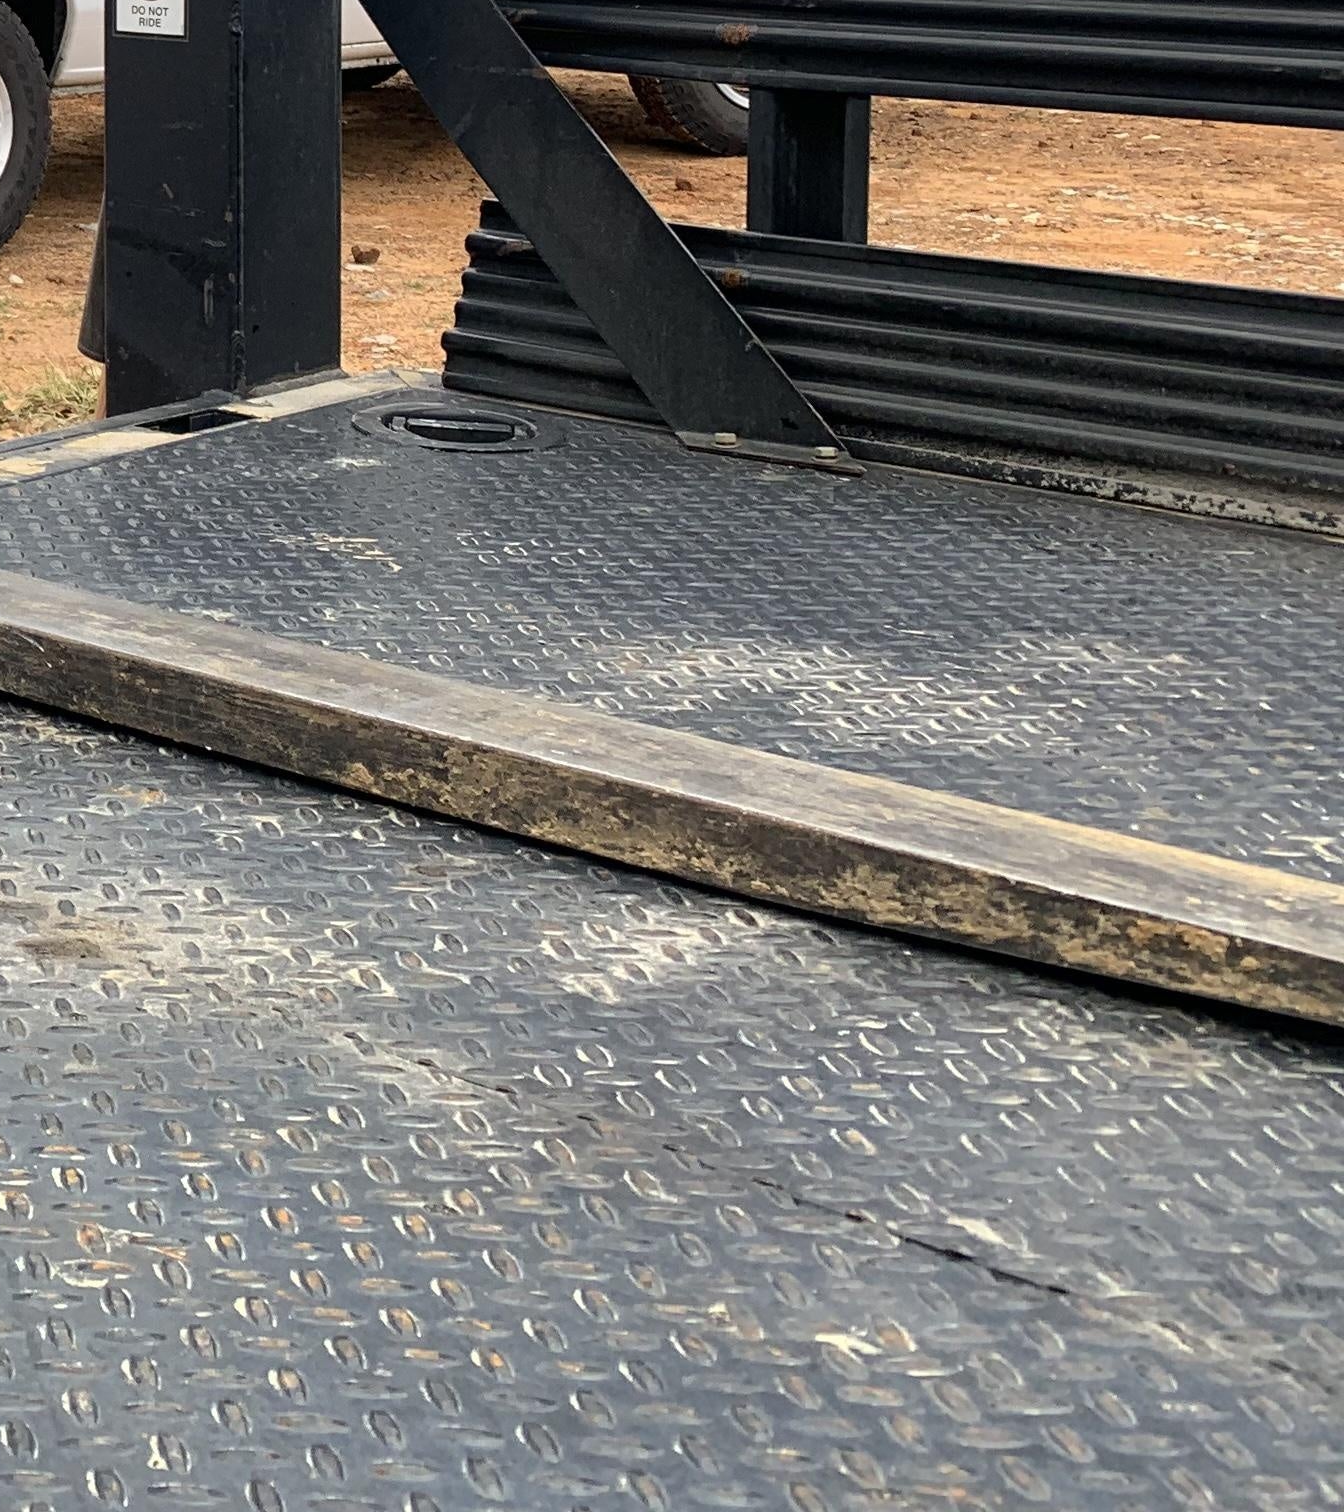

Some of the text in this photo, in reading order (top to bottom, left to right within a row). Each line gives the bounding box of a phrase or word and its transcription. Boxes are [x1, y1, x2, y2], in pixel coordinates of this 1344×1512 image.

[132, 5, 169, 17] DO NOT
[138, 17, 161, 28] RIDE
